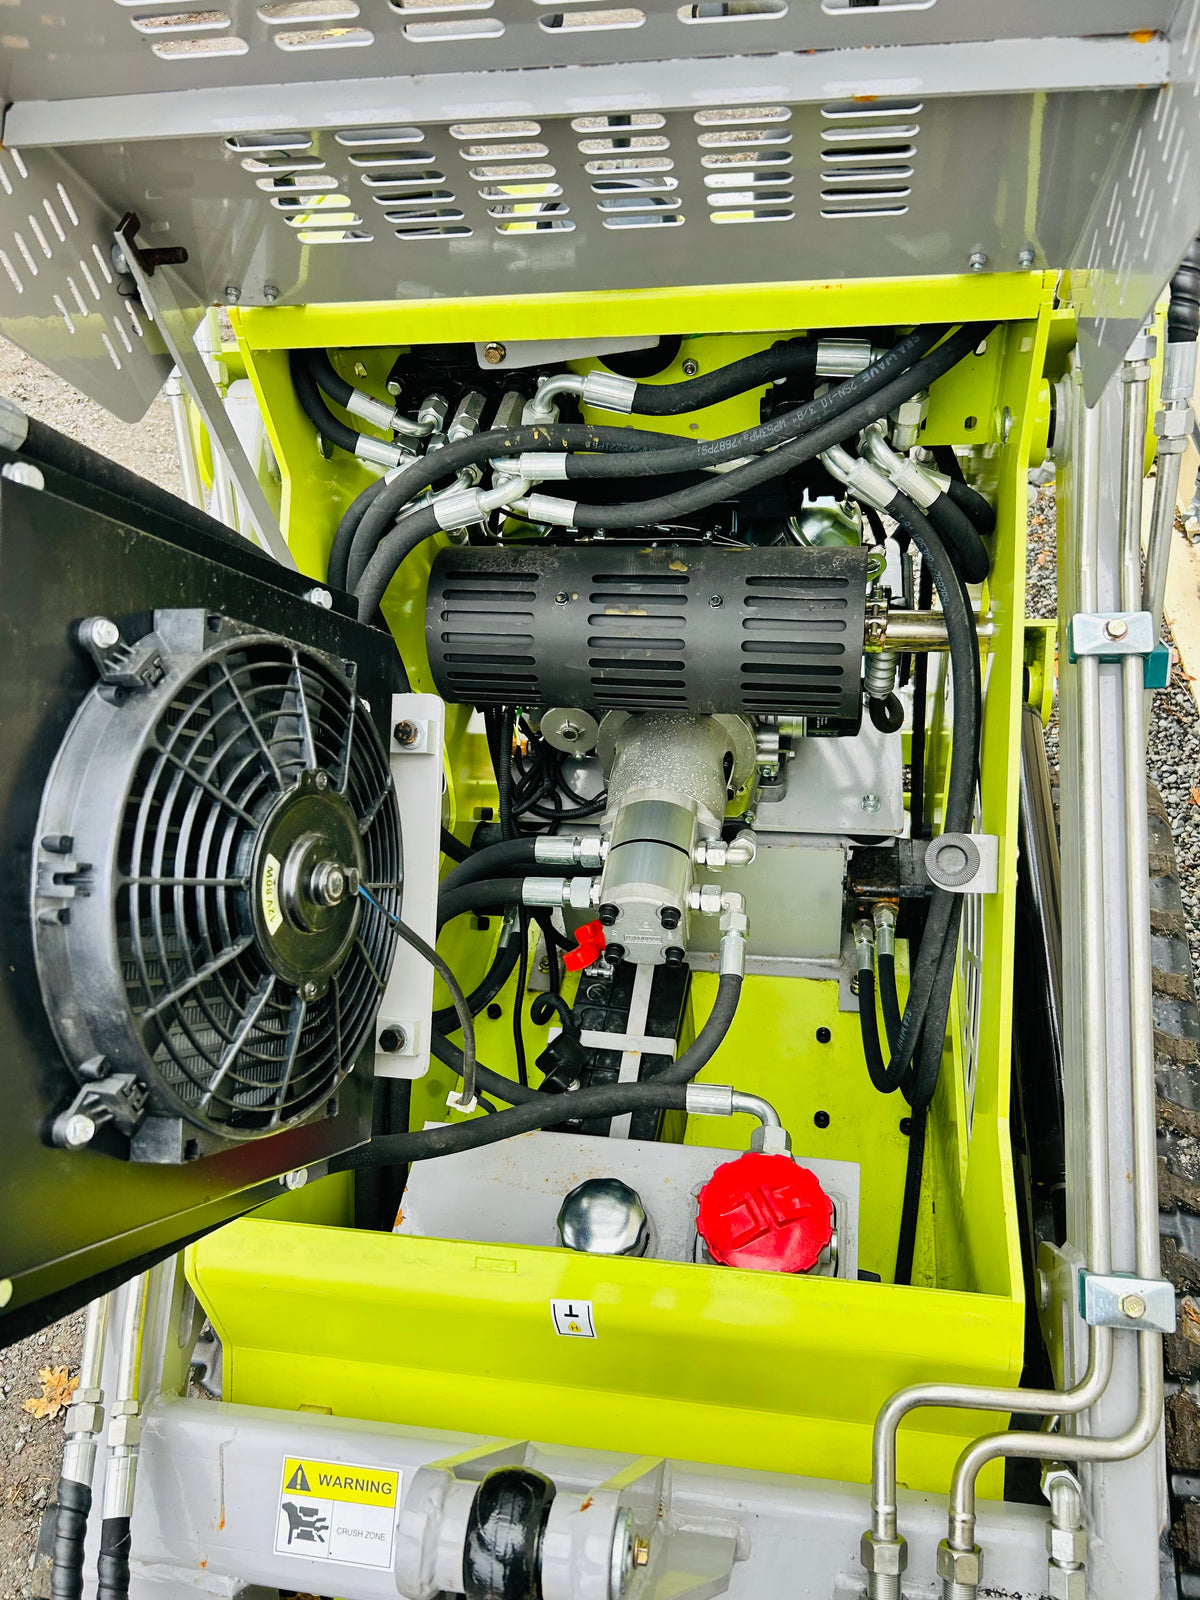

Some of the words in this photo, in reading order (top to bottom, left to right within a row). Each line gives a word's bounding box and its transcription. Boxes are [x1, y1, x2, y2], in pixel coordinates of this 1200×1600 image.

[899, 334, 920, 354] SEA
[862, 353, 898, 382] WAVE
[820, 381, 858, 408] 2SN-10
[793, 404, 817, 423] 3/8"
[266, 899, 276, 922] 12V
[319, 1473, 392, 1495] WARNING
[336, 1526, 364, 1538] CRUSH
[364, 1529, 386, 1541] ZONE
